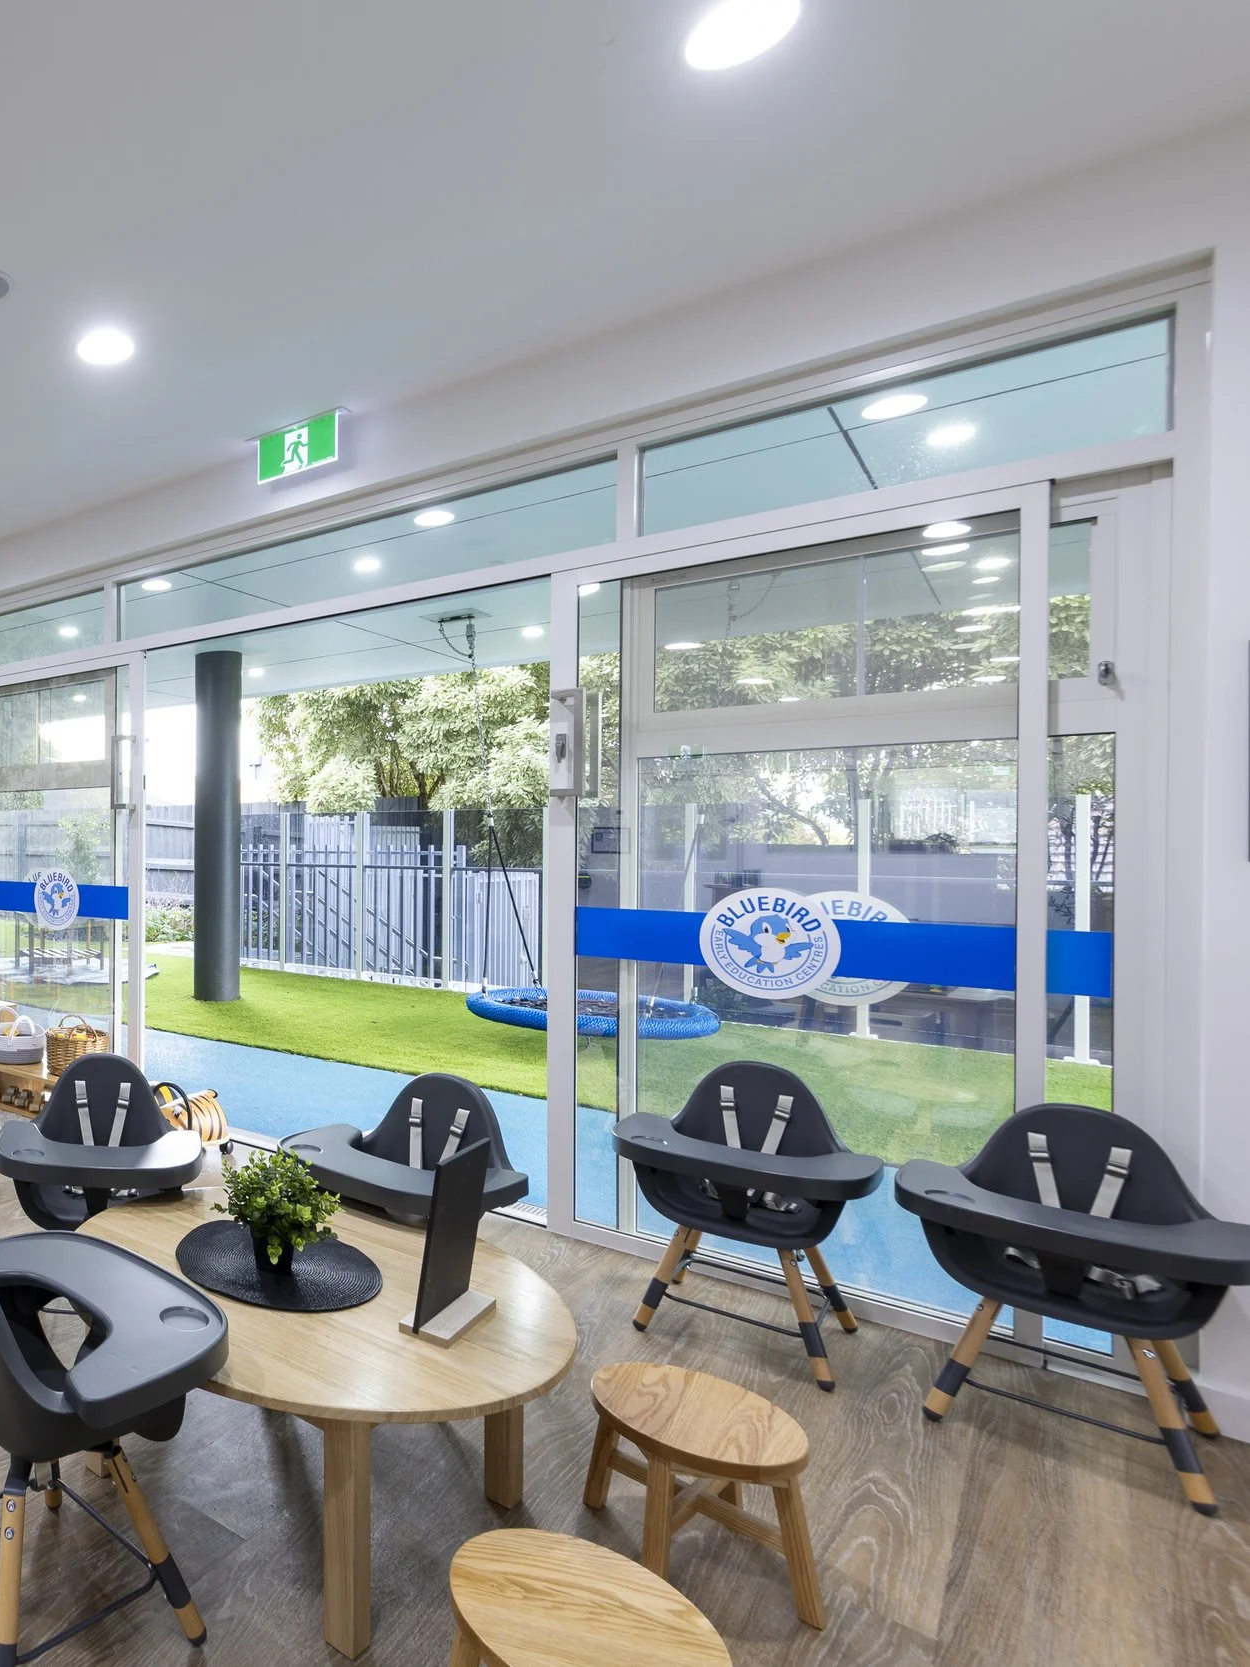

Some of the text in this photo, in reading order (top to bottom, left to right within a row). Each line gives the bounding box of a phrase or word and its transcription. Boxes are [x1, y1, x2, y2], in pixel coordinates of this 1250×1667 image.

[40, 872, 74, 892] BLUEBIRD
[716, 896, 822, 933] BLUEBIRD
[715, 930, 824, 987] EARLY EDUCATION CENTRES
